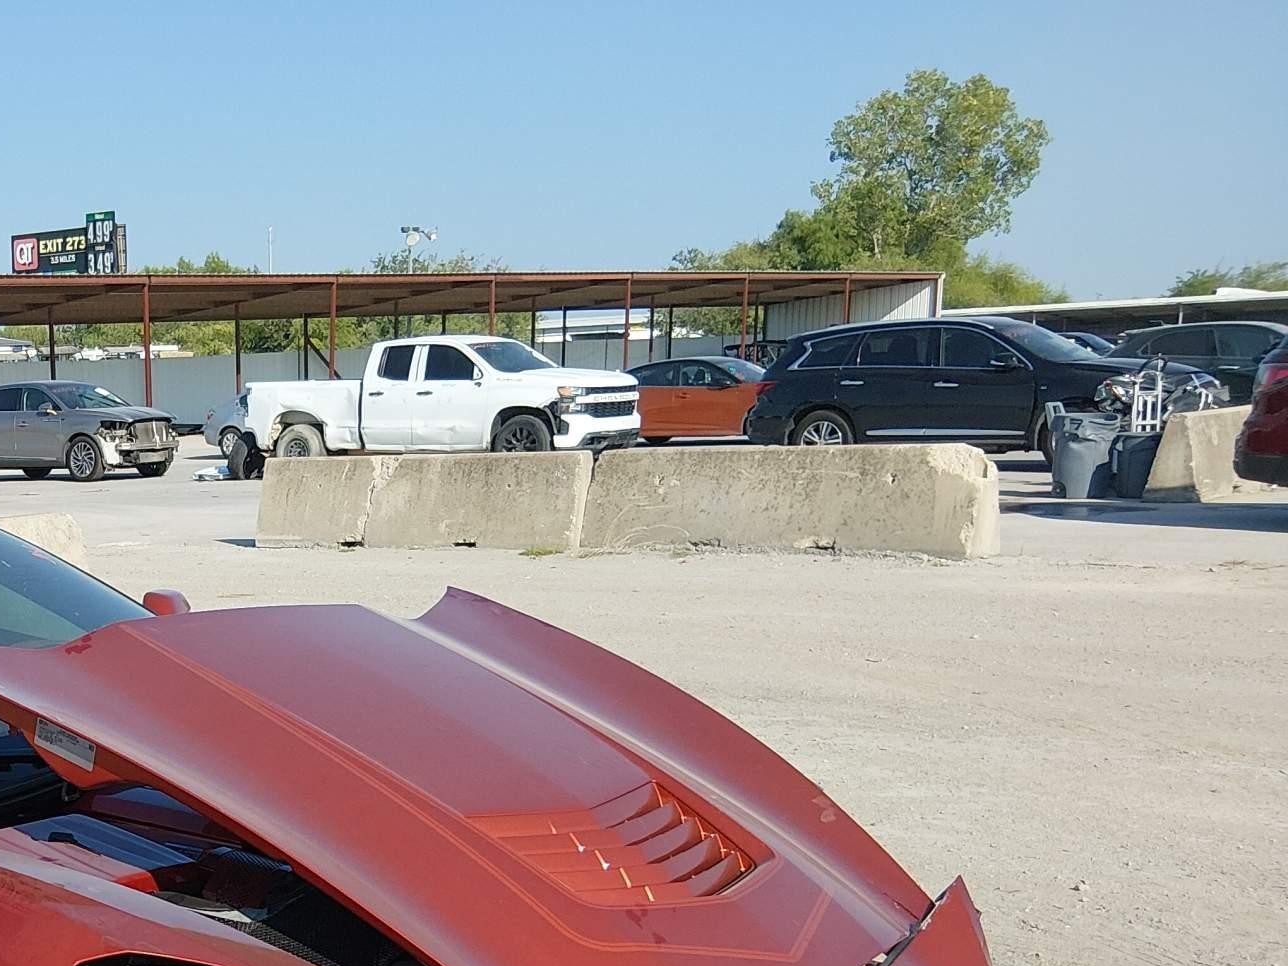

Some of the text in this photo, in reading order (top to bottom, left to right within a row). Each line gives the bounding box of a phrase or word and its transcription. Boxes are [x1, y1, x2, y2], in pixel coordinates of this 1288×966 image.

[16, 242, 34, 265] QT
[39, 235, 86, 253] EXIT 273
